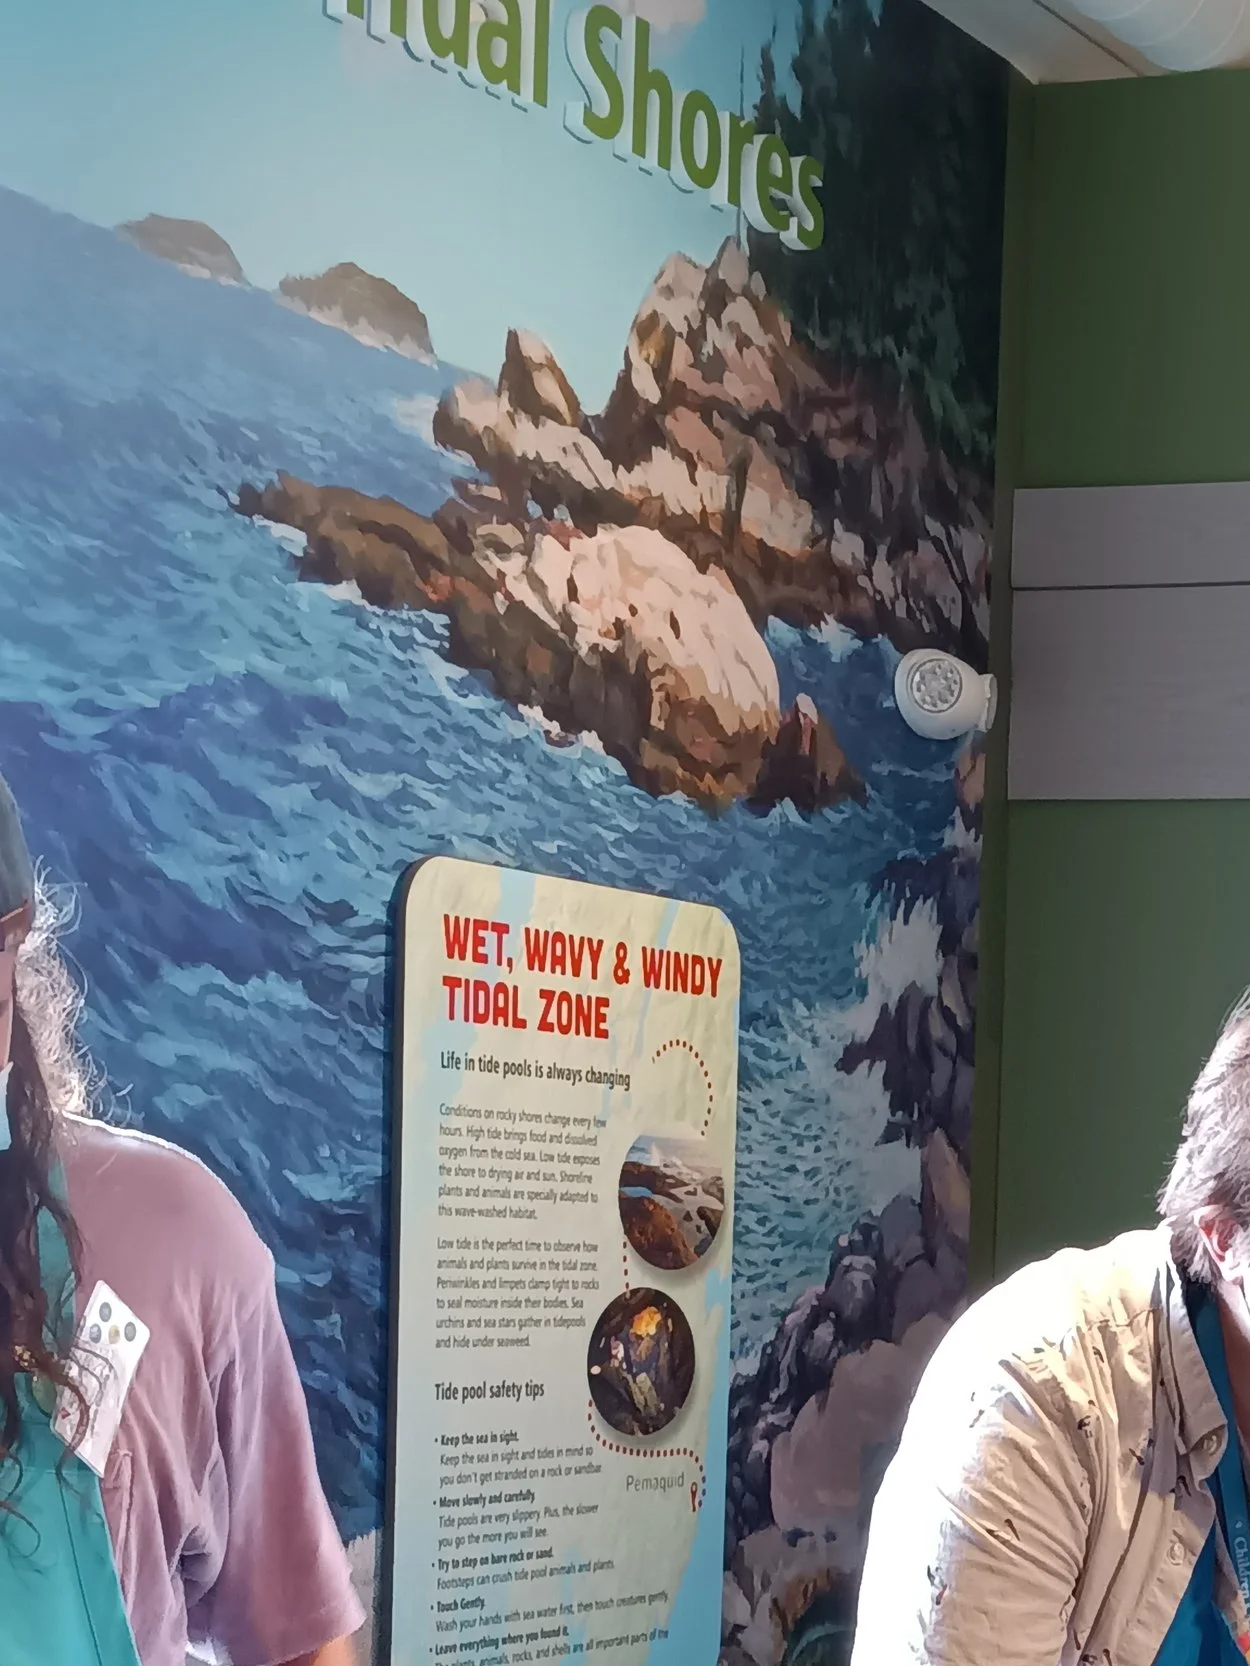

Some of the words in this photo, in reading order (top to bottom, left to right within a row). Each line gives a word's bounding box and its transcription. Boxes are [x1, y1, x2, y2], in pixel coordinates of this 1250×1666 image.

[567, 4, 825, 251] Shores
[444, 914, 513, 974] WET,
[525, 928, 604, 980] WAVY
[613, 942, 630, 985] &
[642, 946, 722, 998] WINDY
[442, 976, 527, 1030] TIDAL
[538, 989, 610, 1039] ZONE
[441, 1052, 461, 1070] Life
[465, 1057, 474, 1071] in
[479, 1056, 499, 1074] tide
[503, 1060, 532, 1079] pools
[535, 1062, 543, 1077] is
[547, 1062, 582, 1086] always
[585, 1067, 630, 1092] changing
[440, 1103, 481, 1118] Conditions
[484, 1109, 494, 1119] on
[497, 1109, 516, 1124] rocky
[519, 1110, 542, 1123] shores
[545, 1113, 570, 1128] change
[573, 1117, 591, 1129] every
[593, 1116, 606, 1128] few
[439, 1124, 463, 1136] hours.
[466, 1126, 485, 1141] High
[487, 1128, 502, 1140] tide
[504, 1129, 527, 1144] brings
[530, 1130, 546, 1143] food
[549, 1131, 562, 1144] and
[565, 1133, 597, 1146] dissolved
[439, 1146, 467, 1160] oxygen
[470, 1145, 488, 1158] from
[491, 1146, 503, 1159] the
[505, 1147, 521, 1160] cold
[524, 1152, 538, 1161] sea.
[540, 1151, 554, 1162] Low
[557, 1152, 571, 1163] tide
[573, 1155, 600, 1166] exposes
[439, 1164, 452, 1176] the
[454, 1164, 475, 1177] shore
[478, 1167, 486, 1178] to
[488, 1166, 512, 1182] drying
[514, 1169, 524, 1180] air
[527, 1170, 540, 1181] and
[542, 1173, 558, 1182] sun.
[560, 1170, 592, 1184] Shoreline
[438, 1184, 463, 1198] plants
[465, 1186, 480, 1197] and
[482, 1186, 511, 1199] animals
[514, 1190, 525, 1199] are
[560, 1191, 588, 1203] adapted
[591, 1192, 598, 1203] to
[438, 1205, 452, 1216] this
[455, 1205, 507, 1218] wave-washed
[509, 1206, 538, 1219] habitat.
[437, 1238, 453, 1249] Low
[456, 1237, 471, 1250] tide
[474, 1238, 479, 1250] is
[482, 1238, 494, 1250] the
[496, 1238, 523, 1252] perfect
[525, 1240, 541, 1251] time
[544, 1241, 551, 1251] to
[553, 1240, 580, 1252] observe
[583, 1241, 598, 1252] how
[437, 1257, 467, 1269] animals
[470, 1258, 484, 1269] and
[486, 1258, 509, 1272] plants
[512, 1261, 537, 1271] survive
[540, 1260, 546, 1270] in
[548, 1259, 560, 1271] the
[562, 1259, 577, 1271] tidal
[437, 1277, 480, 1289] Periwinkles
[482, 1278, 496, 1289] and
[499, 1278, 525, 1291] limpets
[528, 1278, 550, 1290] clamp
[553, 1279, 569, 1293] tight
[572, 1280, 579, 1290] to
[581, 1279, 599, 1290] rocks
[437, 1298, 445, 1308] to
[448, 1296, 462, 1309] seal
[465, 1298, 498, 1308] moisture
[501, 1297, 522, 1308] inside
[525, 1297, 541, 1308] their
[572, 1297, 583, 1308] Sea
[436, 1316, 464, 1328] urchins
[467, 1317, 481, 1328] and
[484, 1319, 496, 1328] sea
[498, 1318, 516, 1328] stars
[518, 1317, 542, 1331] gather
[544, 1317, 550, 1328] in
[436, 1336, 450, 1348] and
[453, 1336, 470, 1348] hide
[472, 1335, 493, 1347] under
[435, 1382, 458, 1400] Tide
[462, 1381, 486, 1403] pool
[490, 1380, 522, 1402] safety
[525, 1380, 544, 1400] tips
[441, 1435, 459, 1447] Keep
[462, 1433, 473, 1445] the
[476, 1434, 488, 1444] sea
[491, 1431, 497, 1443] in
[440, 1475, 454, 1488] you
[457, 1472, 477, 1483] don't
[480, 1471, 492, 1485] get
[495, 1468, 526, 1481] stranded
[529, 1468, 538, 1478] on
[541, 1468, 545, 1478] a
[547, 1465, 562, 1477] rock
[565, 1465, 572, 1475] or
[626, 1472, 684, 1492] Pemaquid
[439, 1497, 460, 1508] Move
[463, 1494, 486, 1508] slowly
[488, 1492, 502, 1503] and
[438, 1559, 449, 1573] Try
[452, 1559, 459, 1569] to
[462, 1557, 477, 1569] step
[480, 1556, 488, 1566] on
[491, 1553, 507, 1564] bare
[509, 1549, 524, 1562] rock
[526, 1551, 533, 1560] or
[437, 1599, 458, 1612] Touch
[435, 1644, 457, 1655] Leave
[460, 1635, 499, 1653] everything
[502, 1632, 523, 1645] where
[525, 1632, 538, 1645] you
[540, 1626, 560, 1639] found
